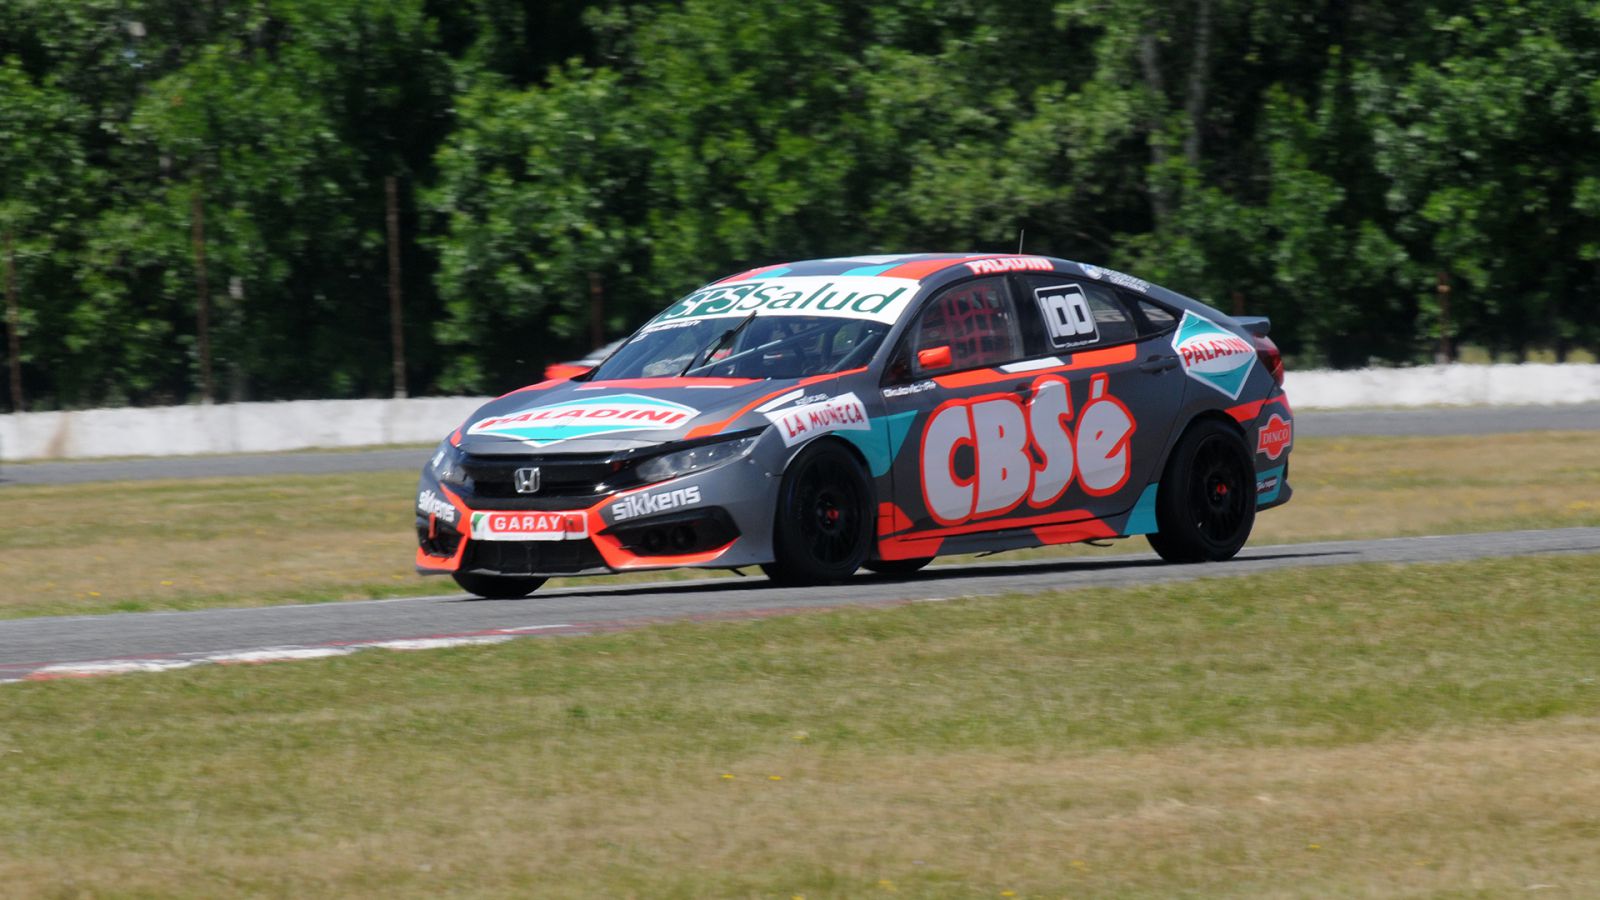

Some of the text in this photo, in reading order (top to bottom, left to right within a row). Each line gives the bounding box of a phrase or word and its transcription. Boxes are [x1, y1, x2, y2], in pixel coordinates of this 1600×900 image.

[966, 258, 1053, 274] PALADINI
[1040, 293, 1094, 338] 100
[478, 409, 687, 430] PALADINI
[783, 402, 865, 438] LA MUÑECA
[920, 373, 1136, 526] CBSé
[1263, 428, 1289, 445] DINCO
[418, 489, 455, 522] sikkens
[611, 485, 701, 521] sikkens
[494, 514, 562, 531] GARAY
